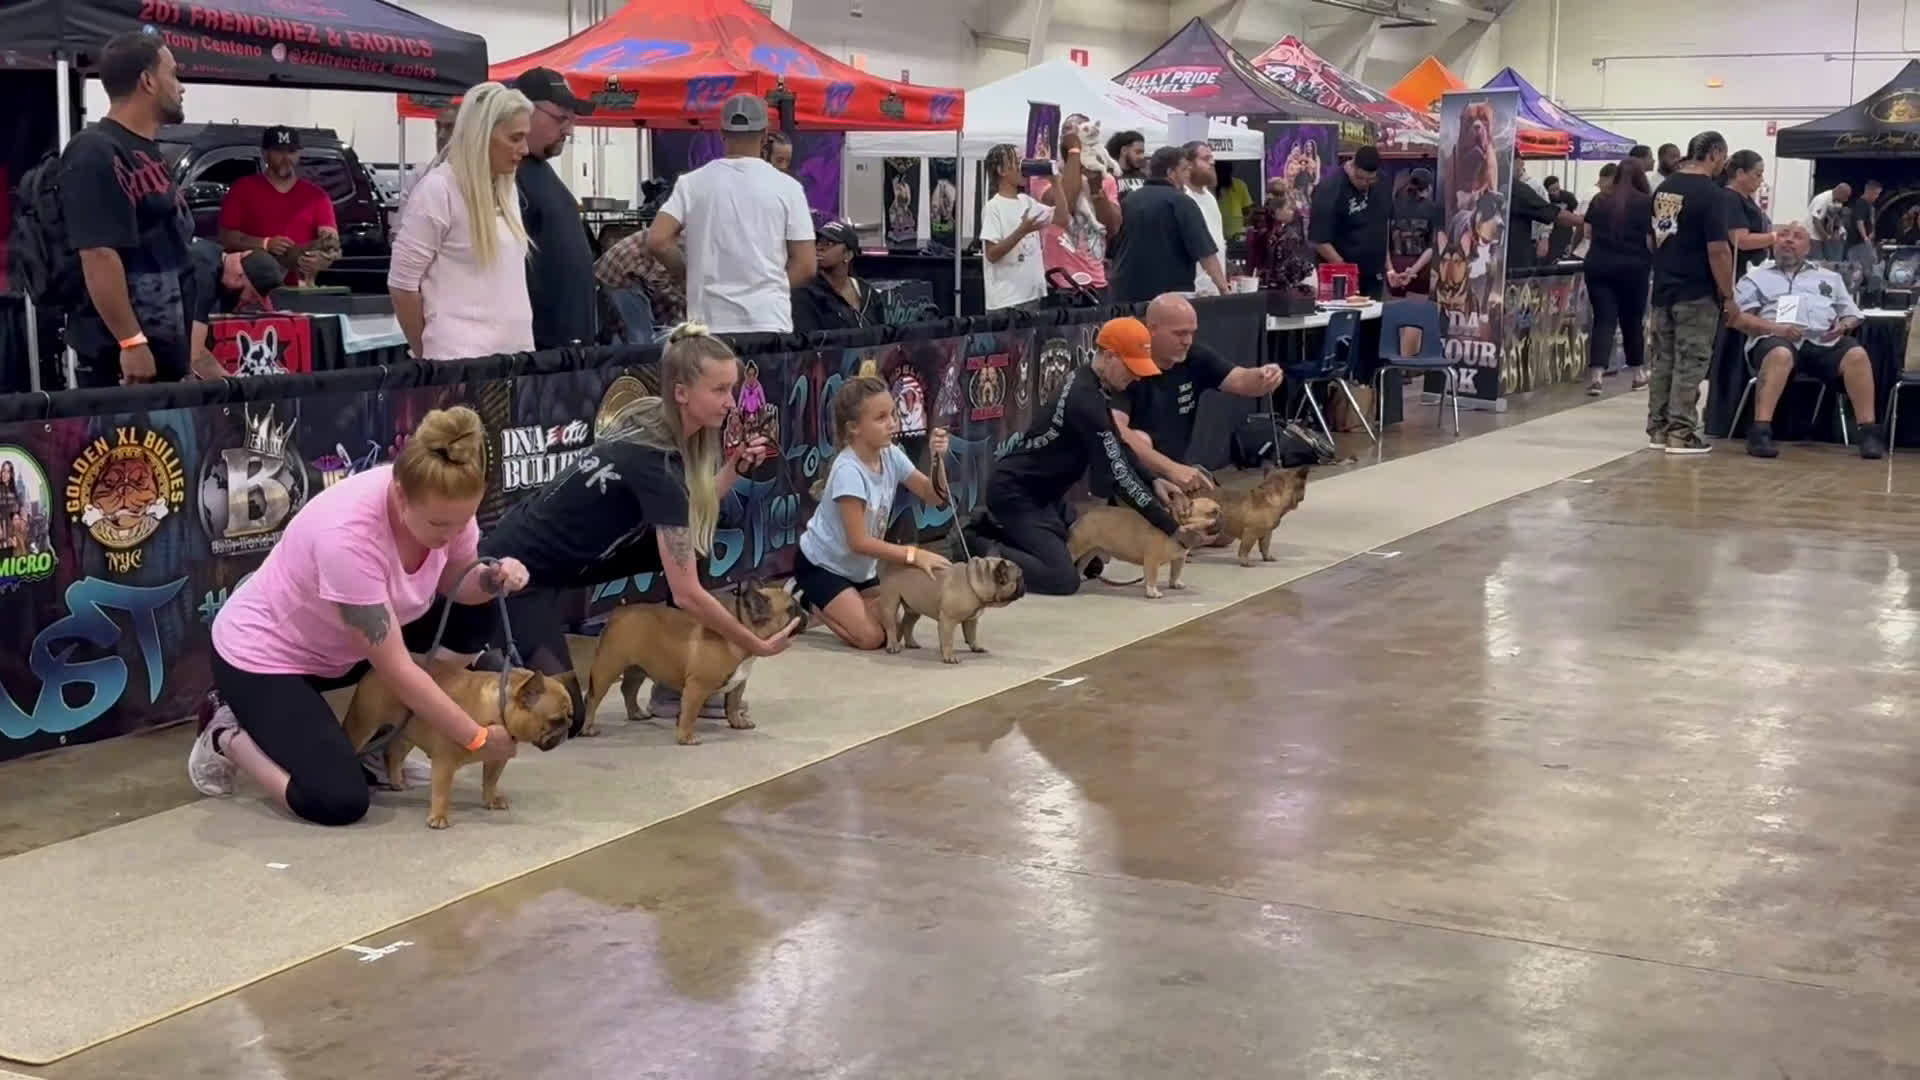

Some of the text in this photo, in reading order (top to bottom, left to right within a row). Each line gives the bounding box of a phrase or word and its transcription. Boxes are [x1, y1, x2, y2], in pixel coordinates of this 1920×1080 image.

[139, 1, 433, 58] 201 FRENCHIEZ & EXOTICS
[163, 31, 199, 53] Tony
[200, 35, 262, 57] Centeno
[1124, 72, 1219, 89] BULLY PRIDE
[277, 131, 290, 144] M
[501, 425, 546, 458] DNA
[66, 427, 185, 513] GOLDEN XL BULLIES
[105, 549, 143, 574] NYC
